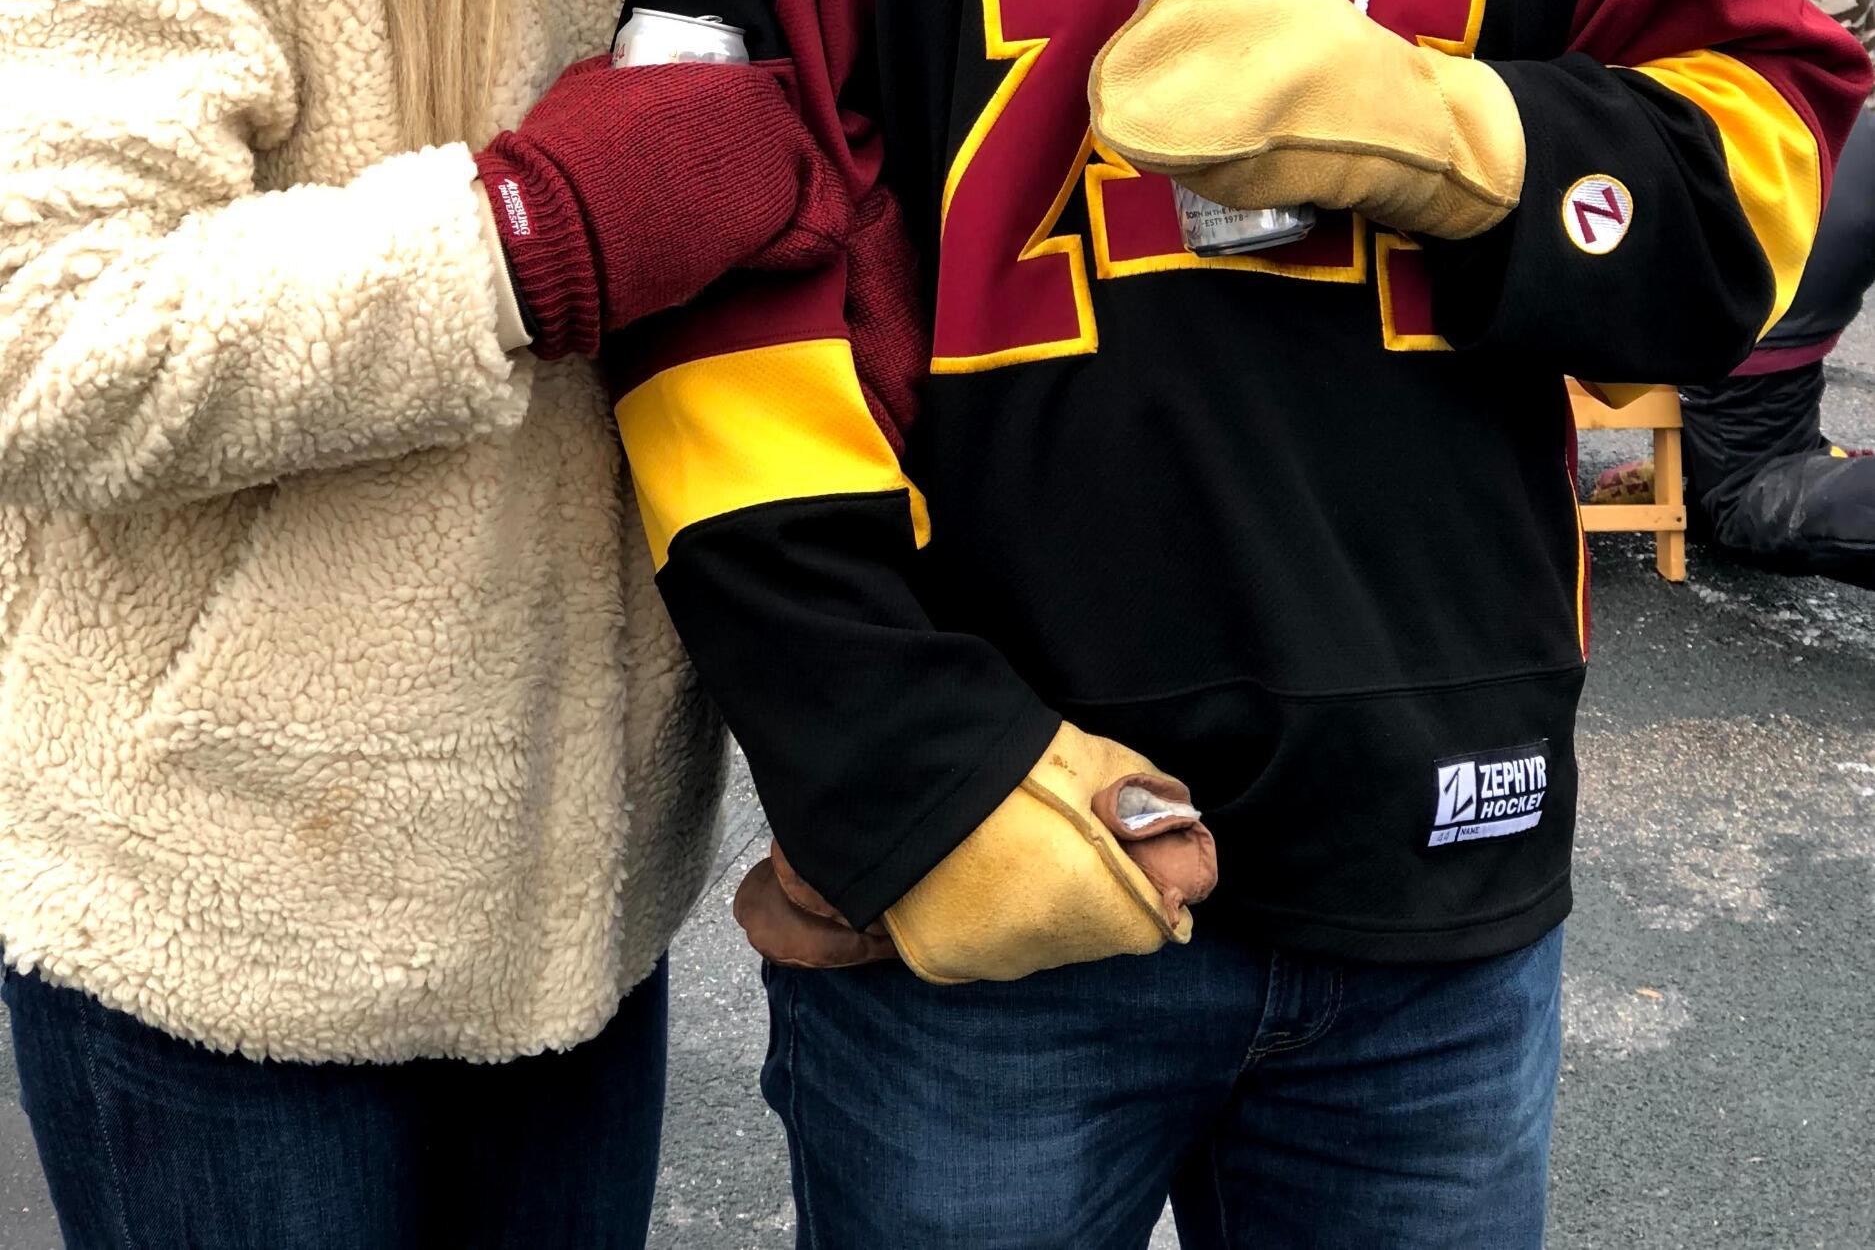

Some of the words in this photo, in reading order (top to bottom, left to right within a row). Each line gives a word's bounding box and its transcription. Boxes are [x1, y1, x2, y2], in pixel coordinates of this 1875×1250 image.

[498, 184, 521, 236] UNIVERSITY
[504, 178, 531, 235] AUGSBURG
[1479, 755, 1547, 799] ZEPHYR
[1480, 791, 1545, 819] HOCKEY
[1460, 826, 1481, 836] NAME
